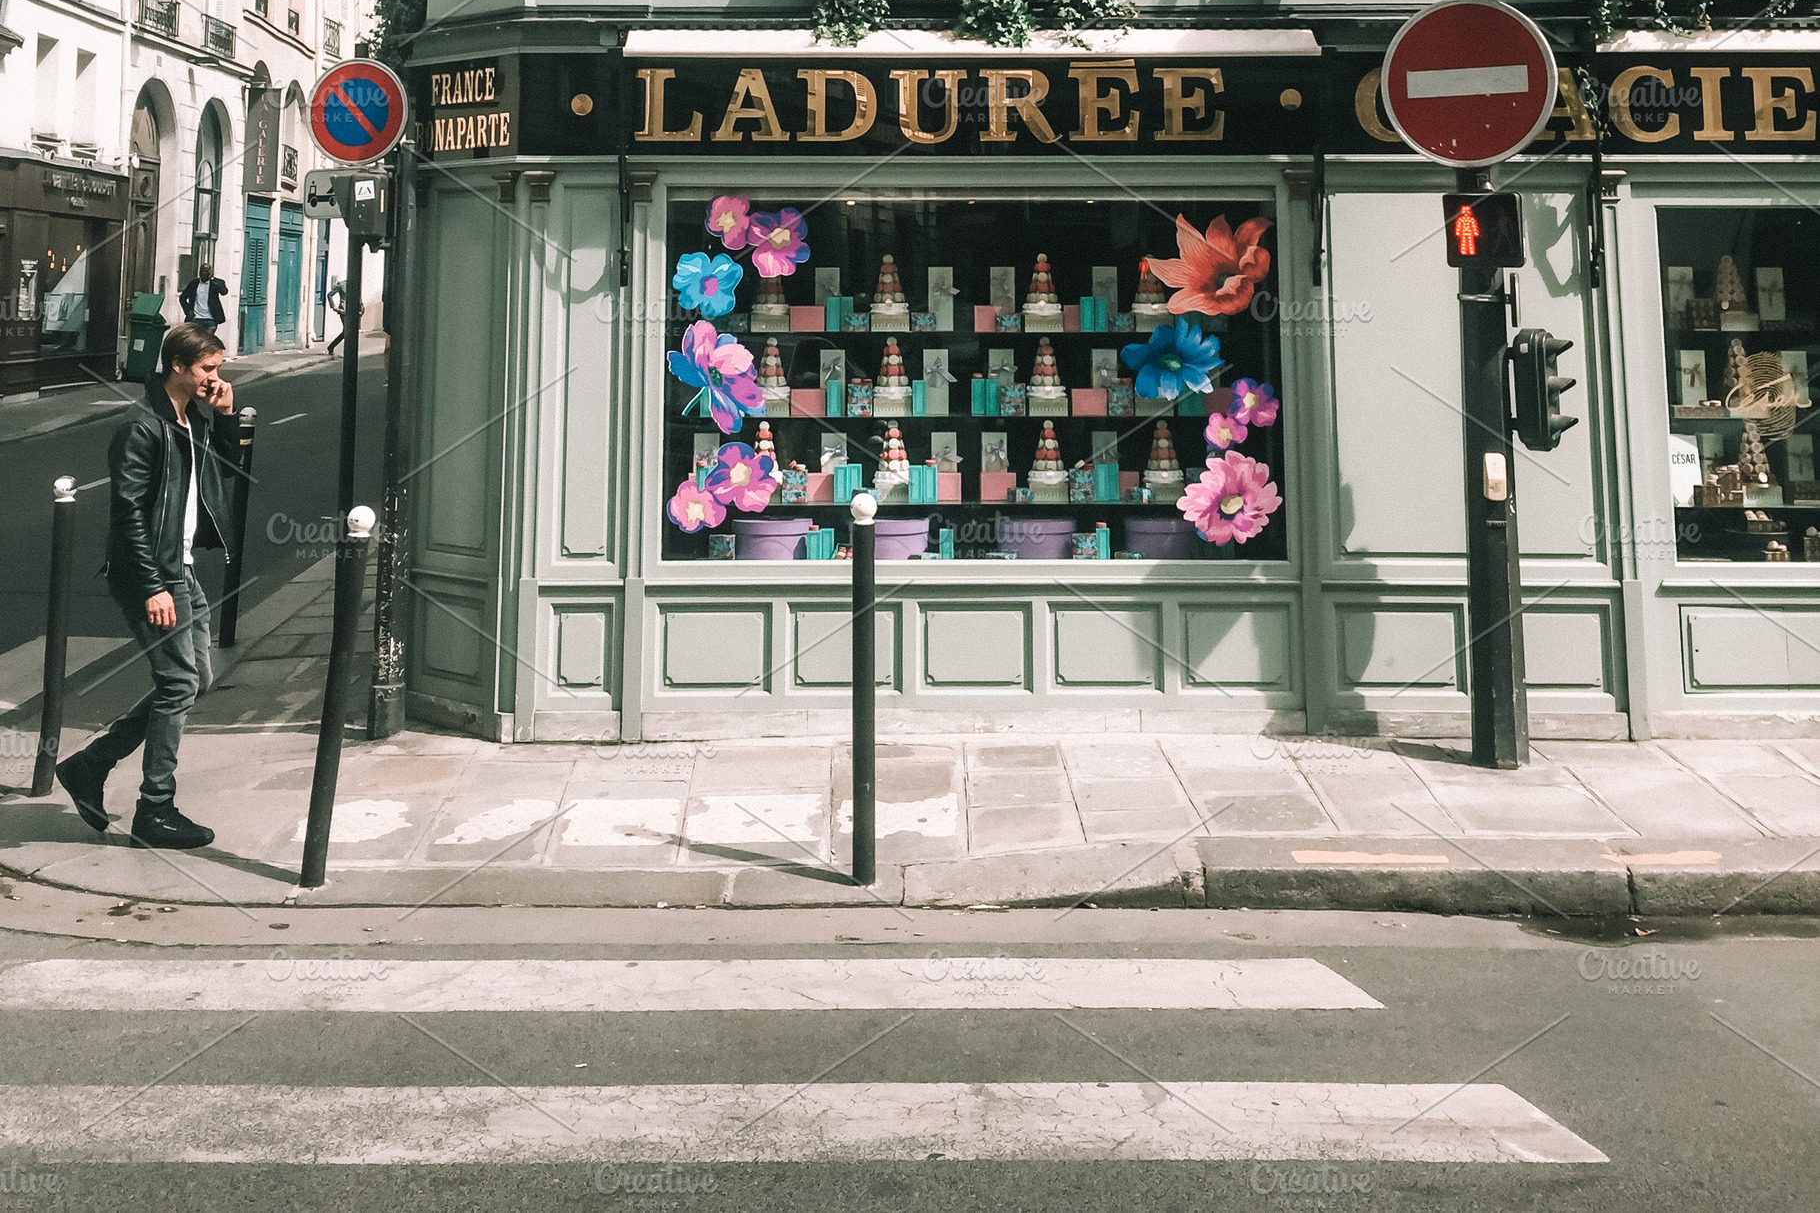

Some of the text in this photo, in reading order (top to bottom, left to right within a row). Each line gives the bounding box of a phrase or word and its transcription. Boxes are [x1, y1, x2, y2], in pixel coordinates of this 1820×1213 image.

[431, 67, 495, 106] FRANCE
[633, 59, 1226, 144] LADURÉE
[256, 120, 268, 184] GALERIE
[1671, 452, 1697, 465] CÉSAR
